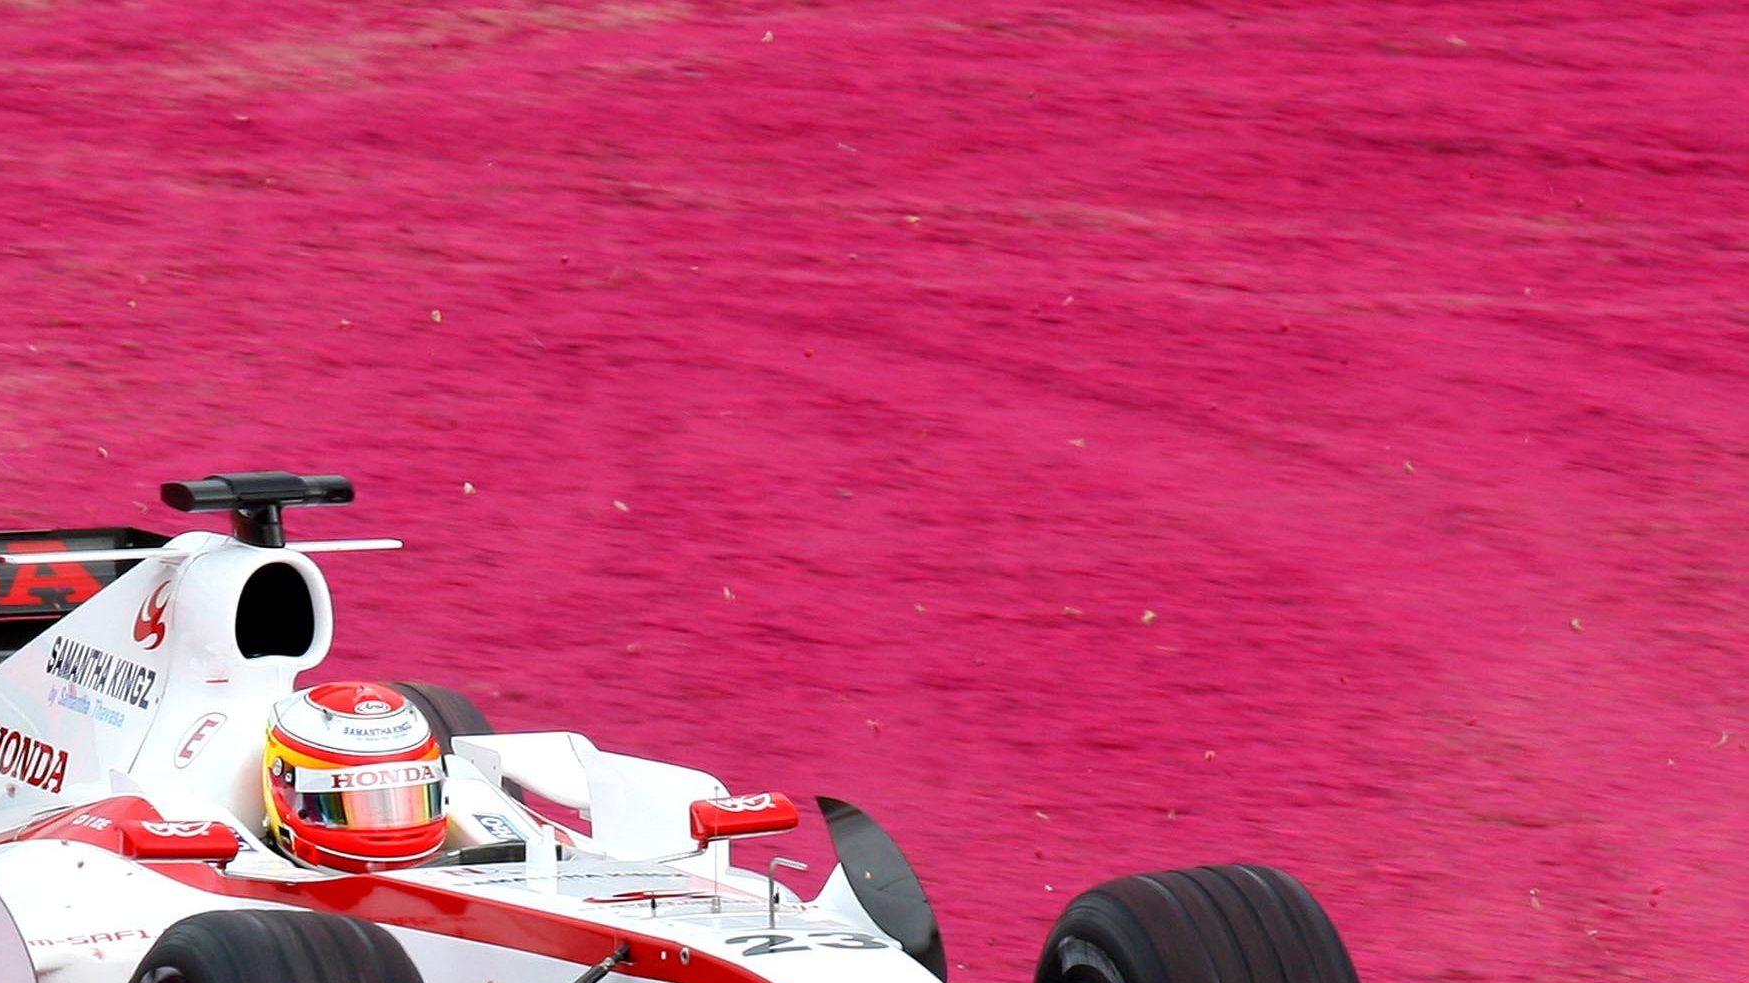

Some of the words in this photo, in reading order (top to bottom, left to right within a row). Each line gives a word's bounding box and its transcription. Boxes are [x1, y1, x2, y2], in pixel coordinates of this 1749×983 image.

[46, 636, 114, 695] SAMANTHA
[106, 658, 157, 710] KINGZ
[177, 719, 220, 760] E
[331, 765, 436, 789] HONDA
[725, 932, 890, 957] 23
